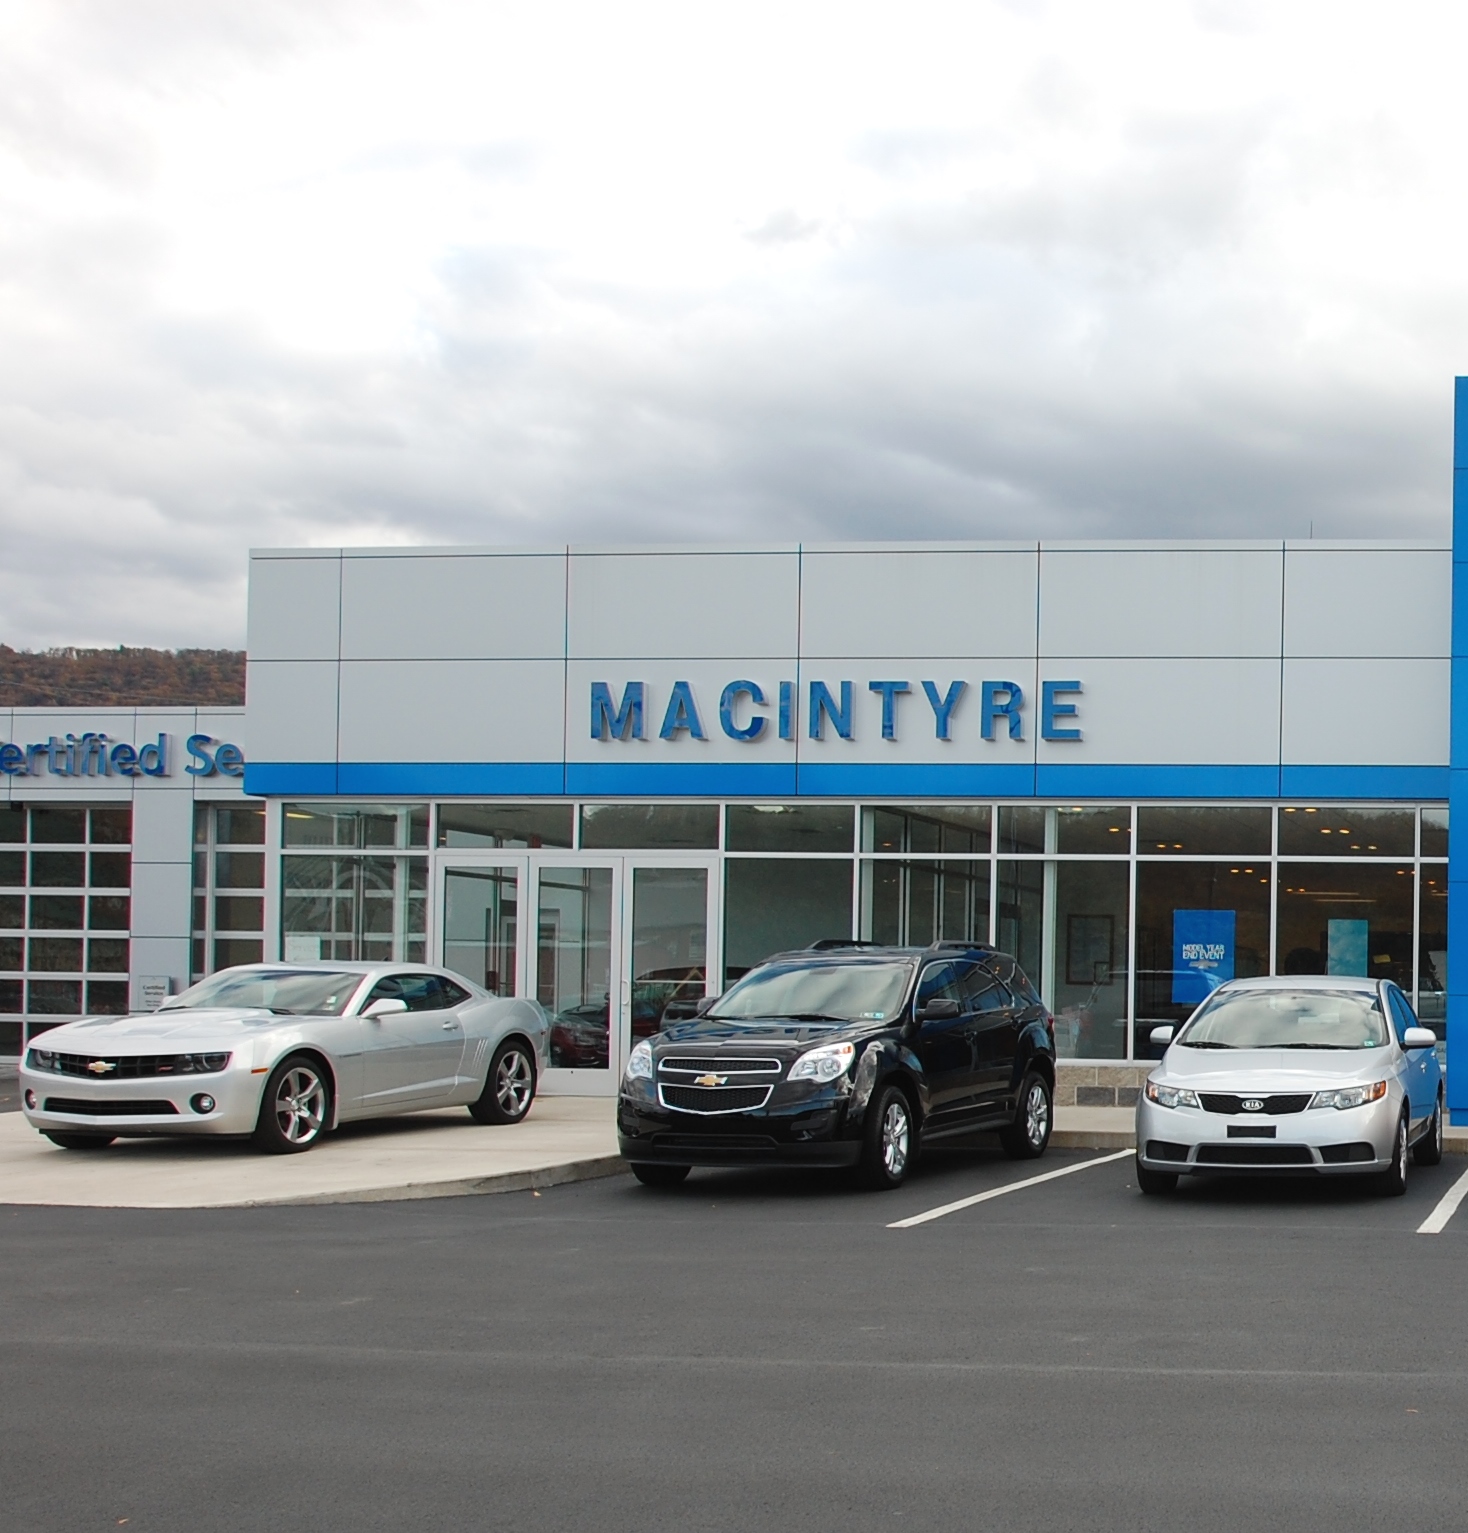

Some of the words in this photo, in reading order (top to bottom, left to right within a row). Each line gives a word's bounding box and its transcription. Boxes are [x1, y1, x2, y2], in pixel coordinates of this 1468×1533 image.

[590, 680, 1084, 742] MACINTYRE
[0, 732, 172, 777] ertified
[184, 733, 244, 777] Se
[1243, 1100, 1262, 1109] KIA
